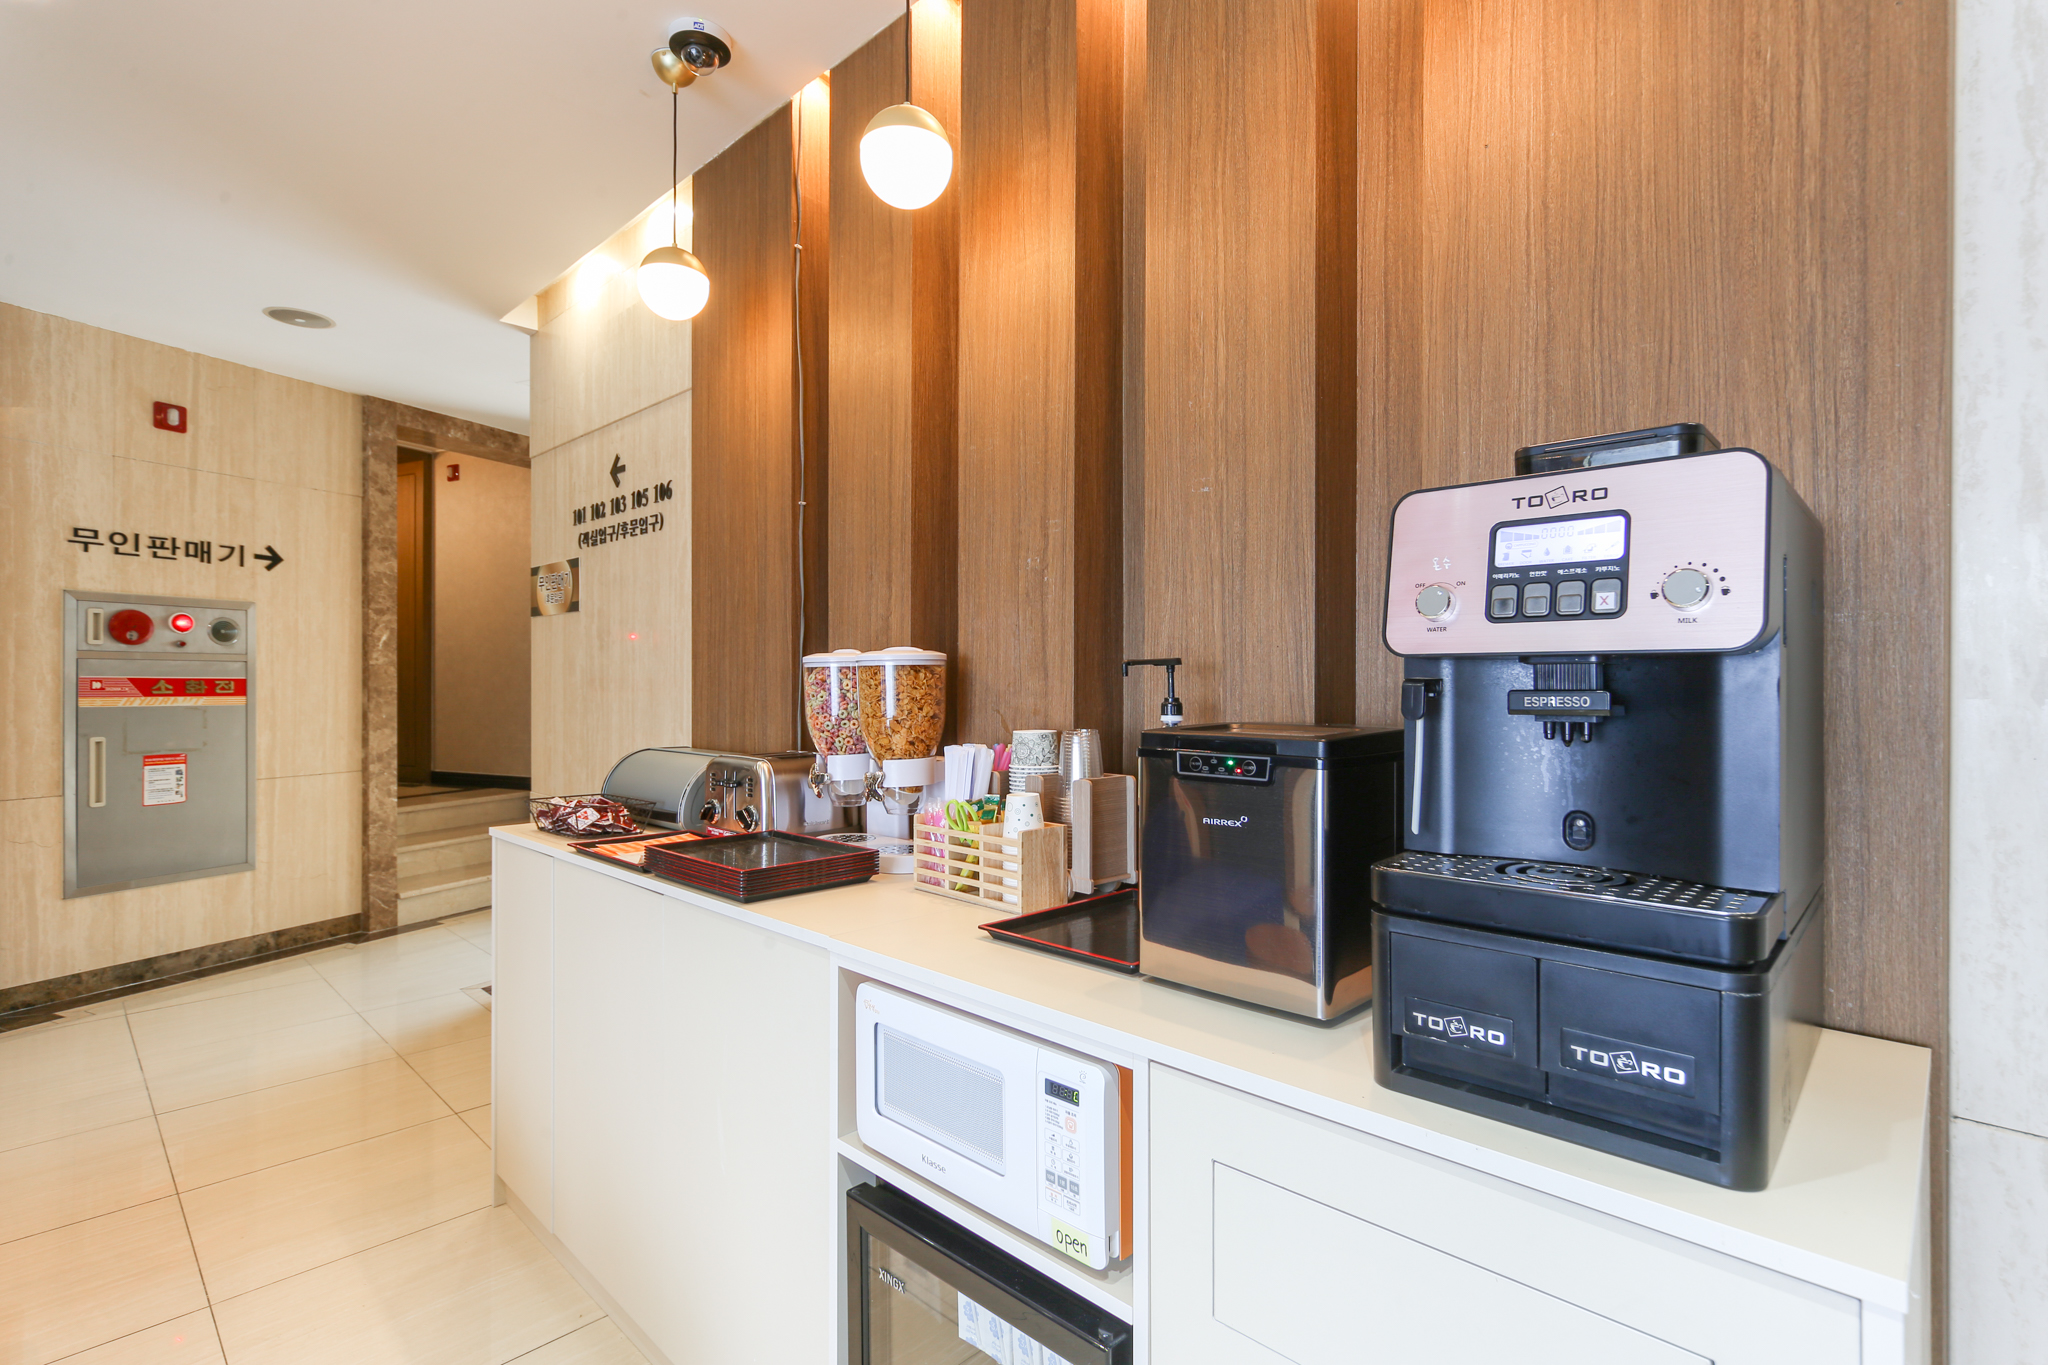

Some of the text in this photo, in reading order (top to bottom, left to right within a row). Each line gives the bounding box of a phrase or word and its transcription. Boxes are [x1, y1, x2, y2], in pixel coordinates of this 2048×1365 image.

[573, 480, 673, 526] 101 102 103 105 106
[67, 527, 245, 567] 무인판매기
[151, 679, 236, 695] 소화전
[1523, 696, 1590, 707] ESPRESSO
[921, 1153, 947, 1174] Klasse
[1056, 1229, 1088, 1257] open
[878, 1267, 905, 1294] XINGX
